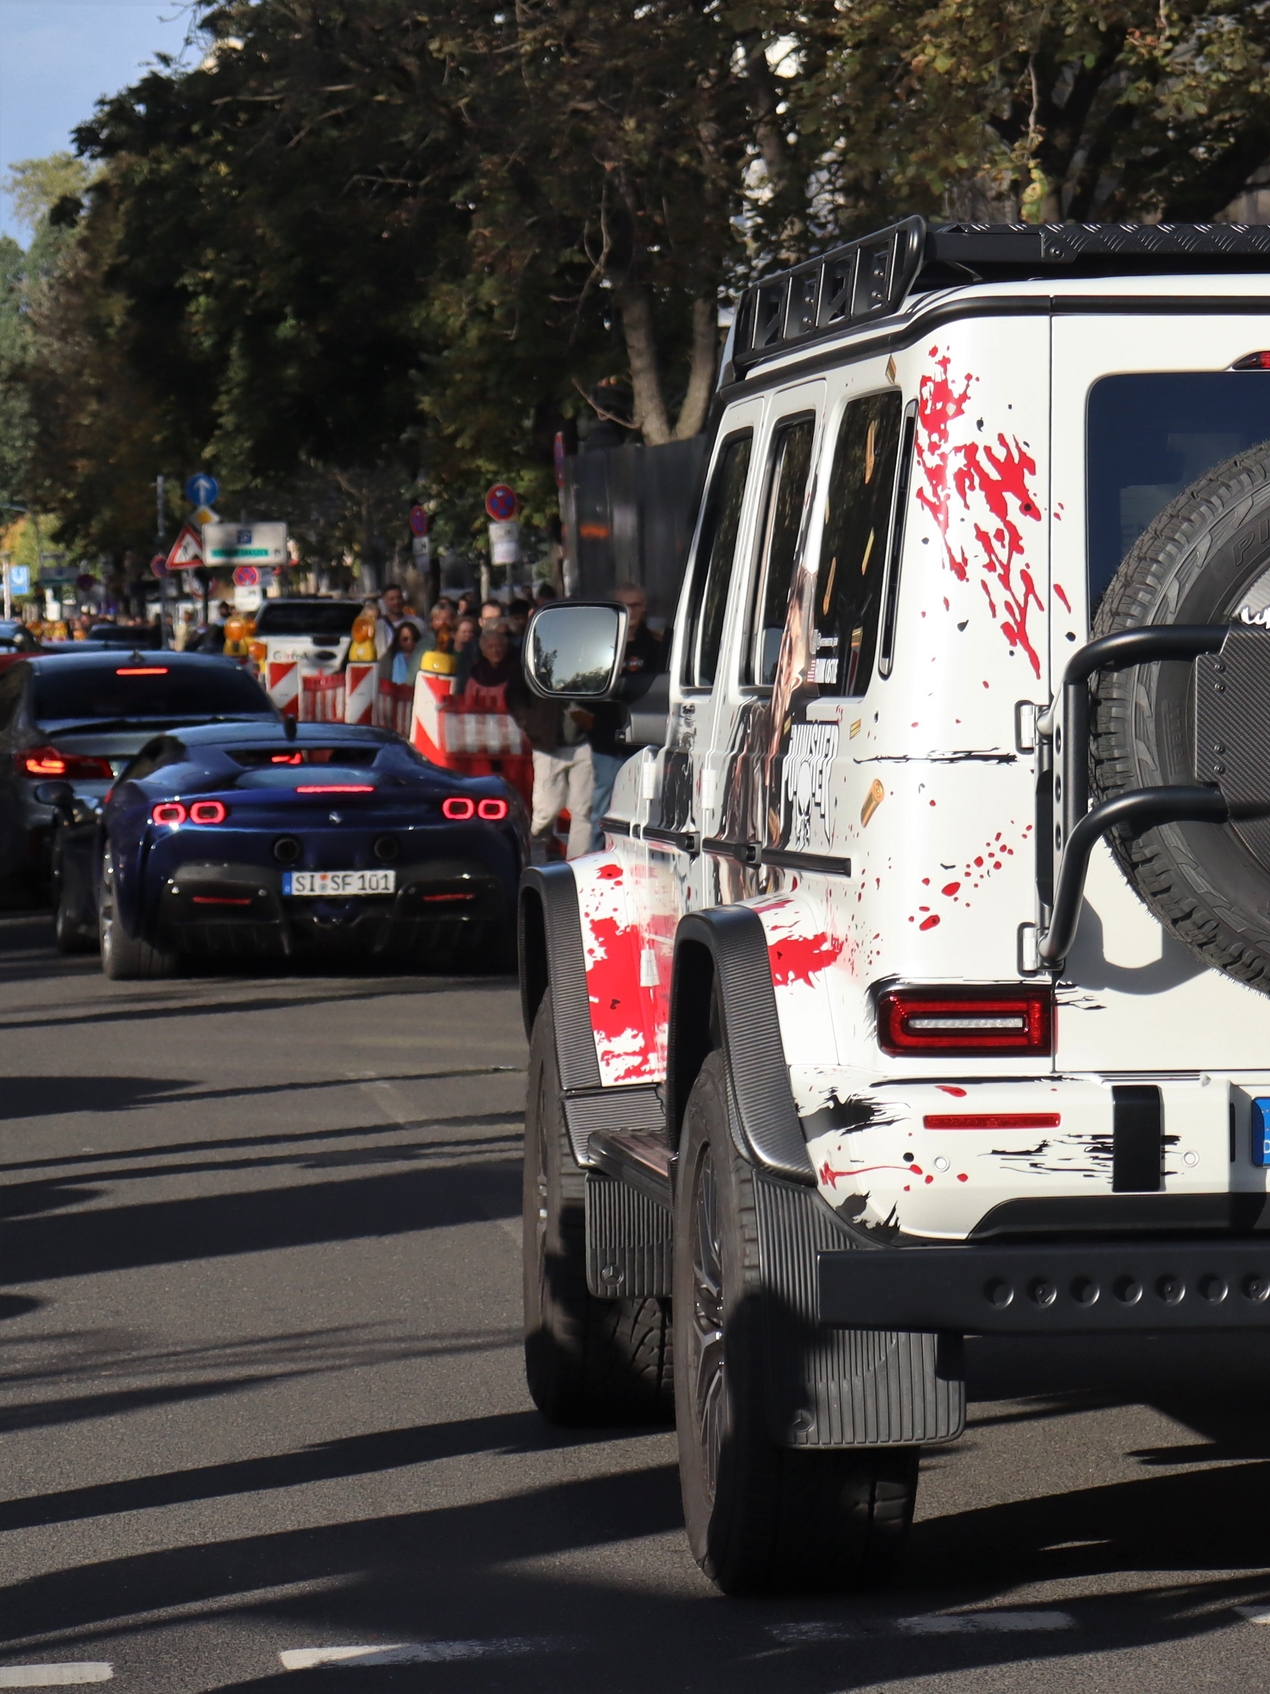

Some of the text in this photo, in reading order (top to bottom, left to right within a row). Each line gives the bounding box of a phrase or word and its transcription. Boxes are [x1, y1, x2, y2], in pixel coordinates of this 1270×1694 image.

[295, 873, 391, 892] SI SF 101
